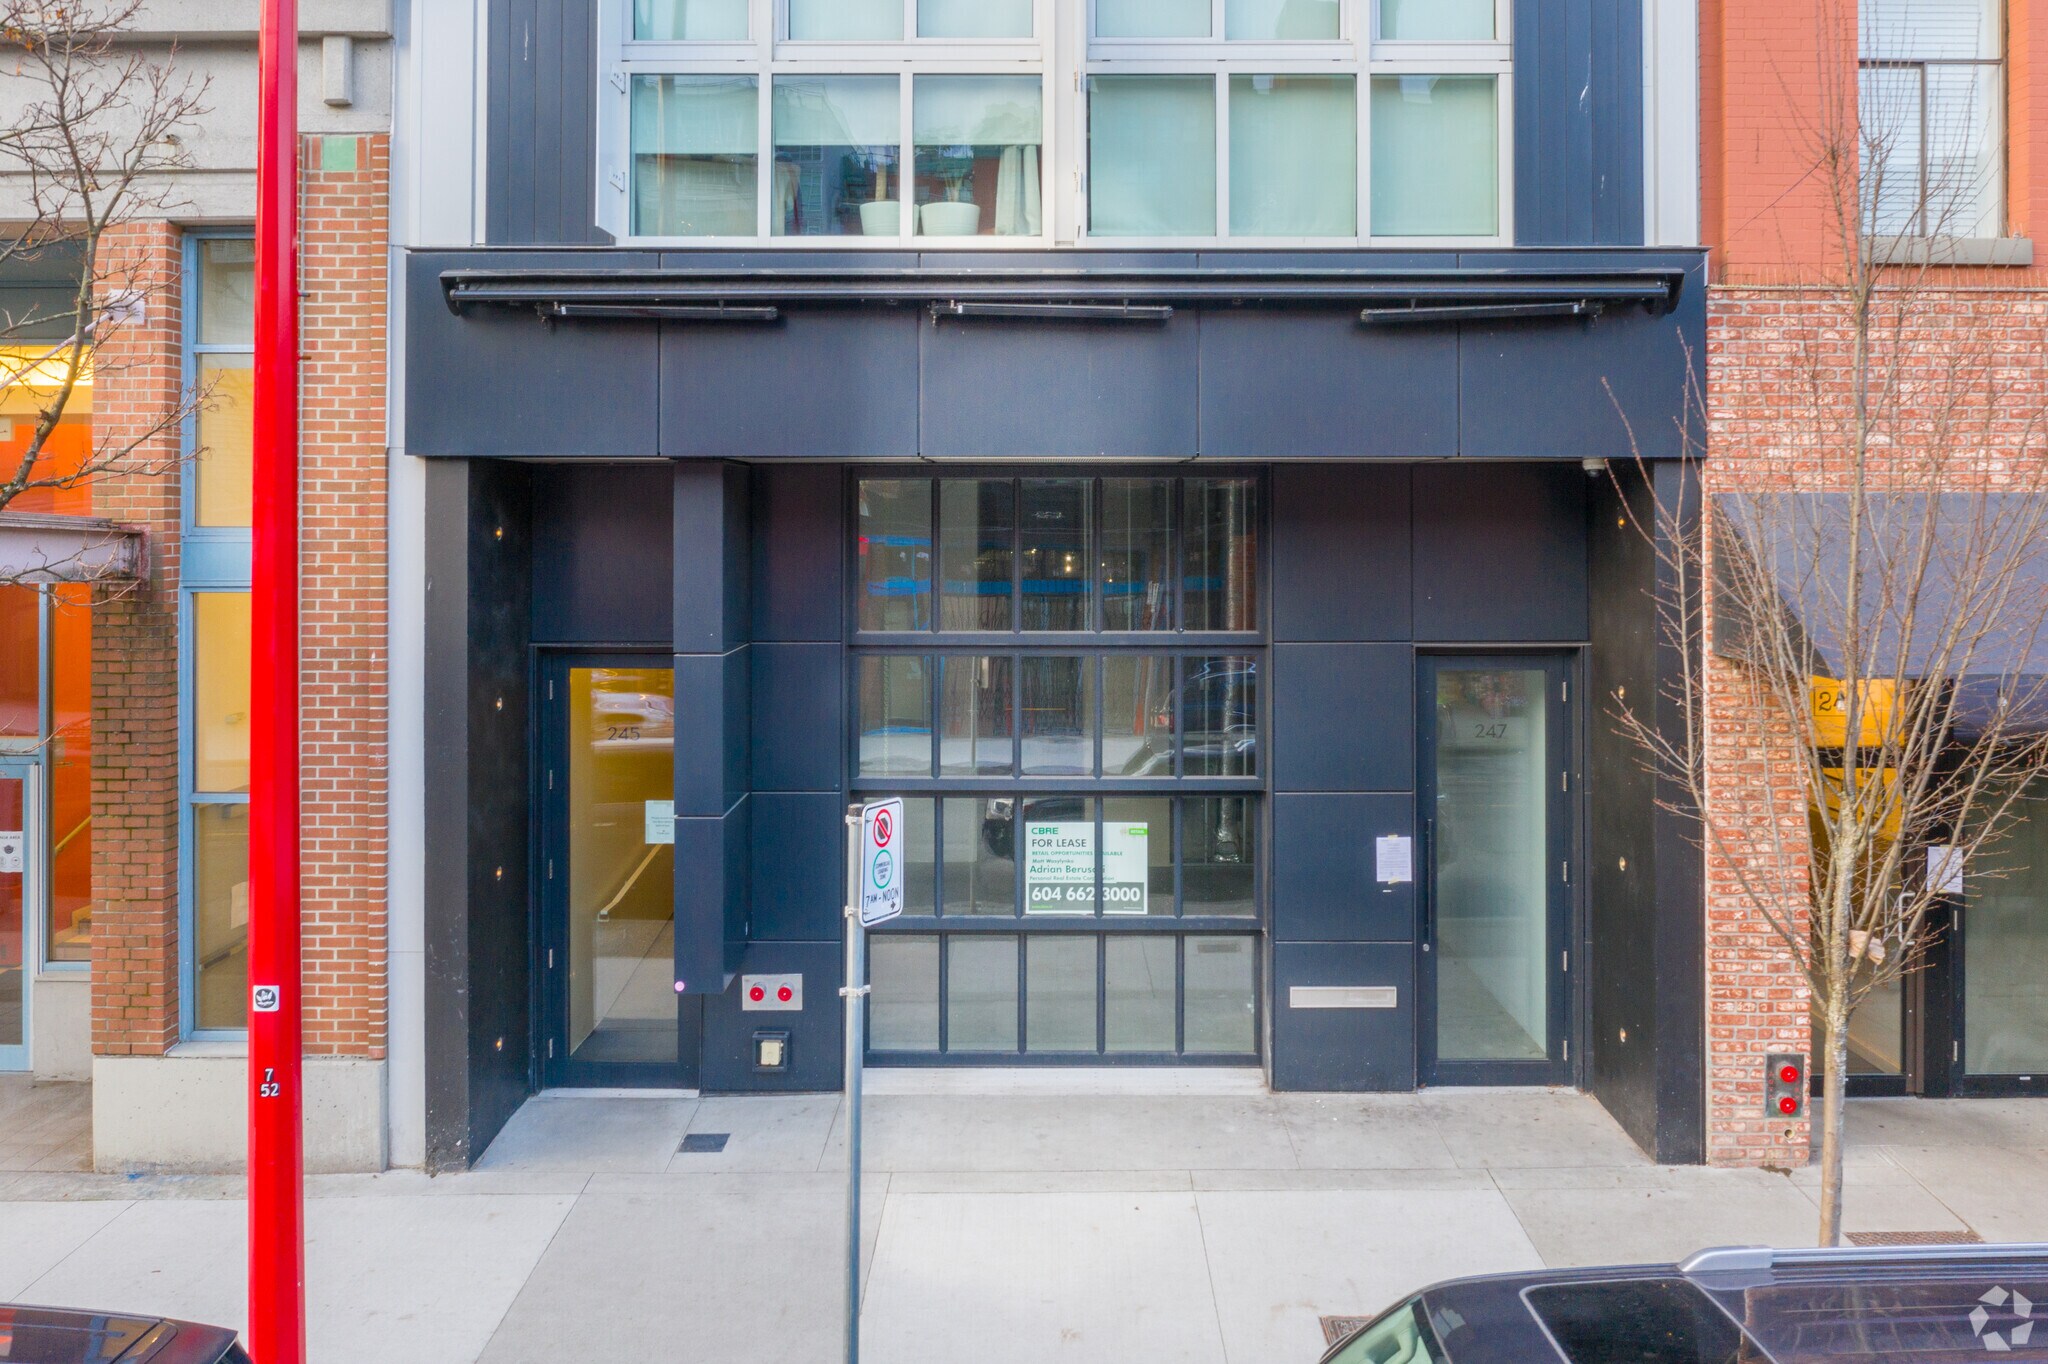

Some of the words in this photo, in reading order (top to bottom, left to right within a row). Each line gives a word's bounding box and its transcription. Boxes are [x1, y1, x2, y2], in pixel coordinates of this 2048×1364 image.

[608, 726, 640, 741] 245
[1475, 723, 1507, 738] 247
[1031, 827, 1059, 835] CBRE
[1032, 839, 1053, 847] FOR
[1056, 839, 1087, 847] LEASE
[1029, 865, 1062, 874] Adrian
[882, 887, 899, 903] NOON
[1031, 887, 1062, 902] 604
[1066, 887, 1095, 902] 662
[1102, 887, 1141, 902] 3000
[265, 1068, 274, 1082] 7
[260, 1083, 279, 1098] 52
